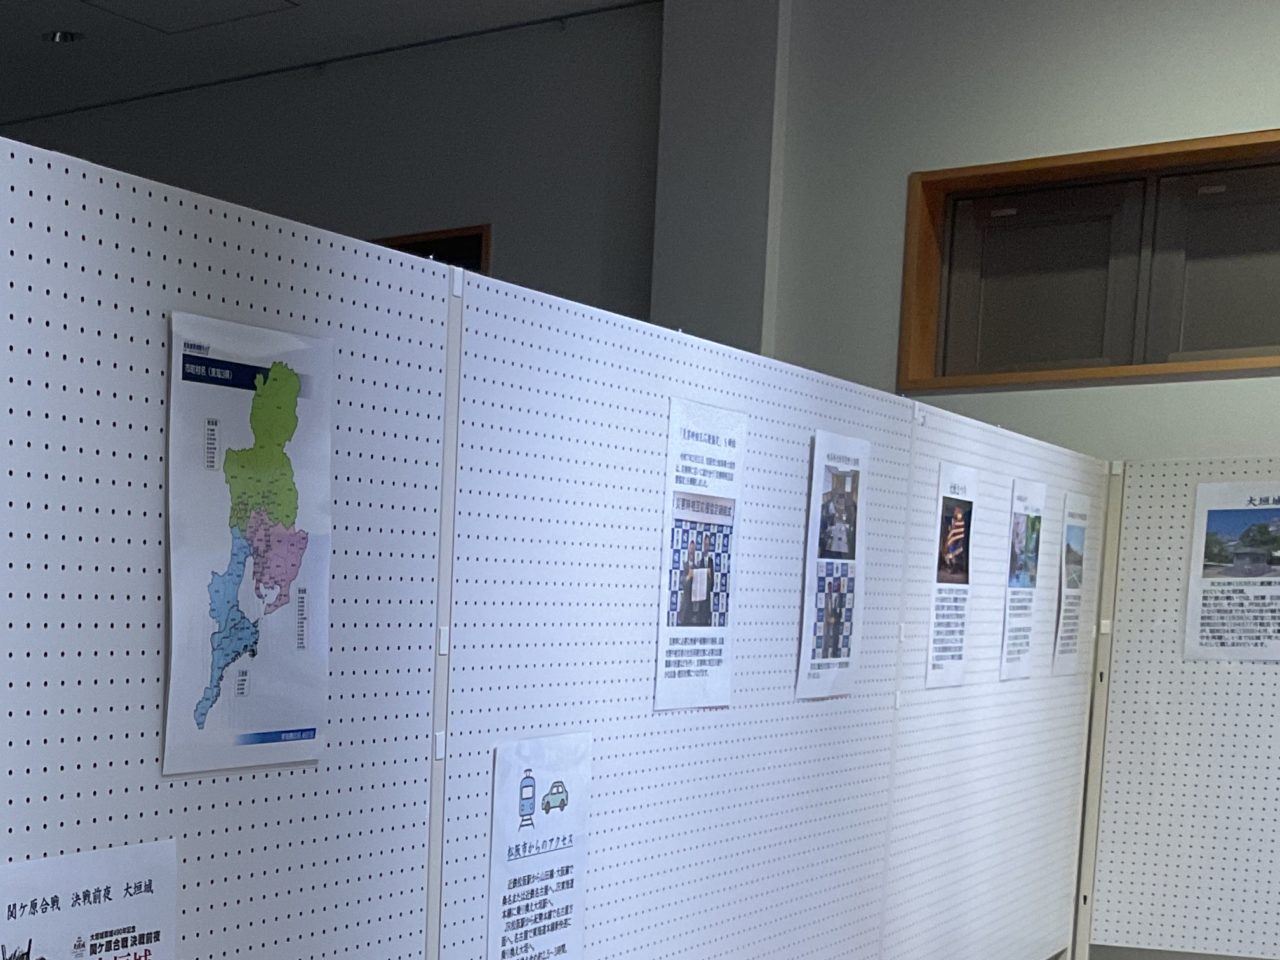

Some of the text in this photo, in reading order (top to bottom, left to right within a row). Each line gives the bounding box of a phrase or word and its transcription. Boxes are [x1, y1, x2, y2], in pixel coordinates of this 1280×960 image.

[70, 885, 113, 908] 決戦前夜
[122, 879, 154, 899] 大垣城
